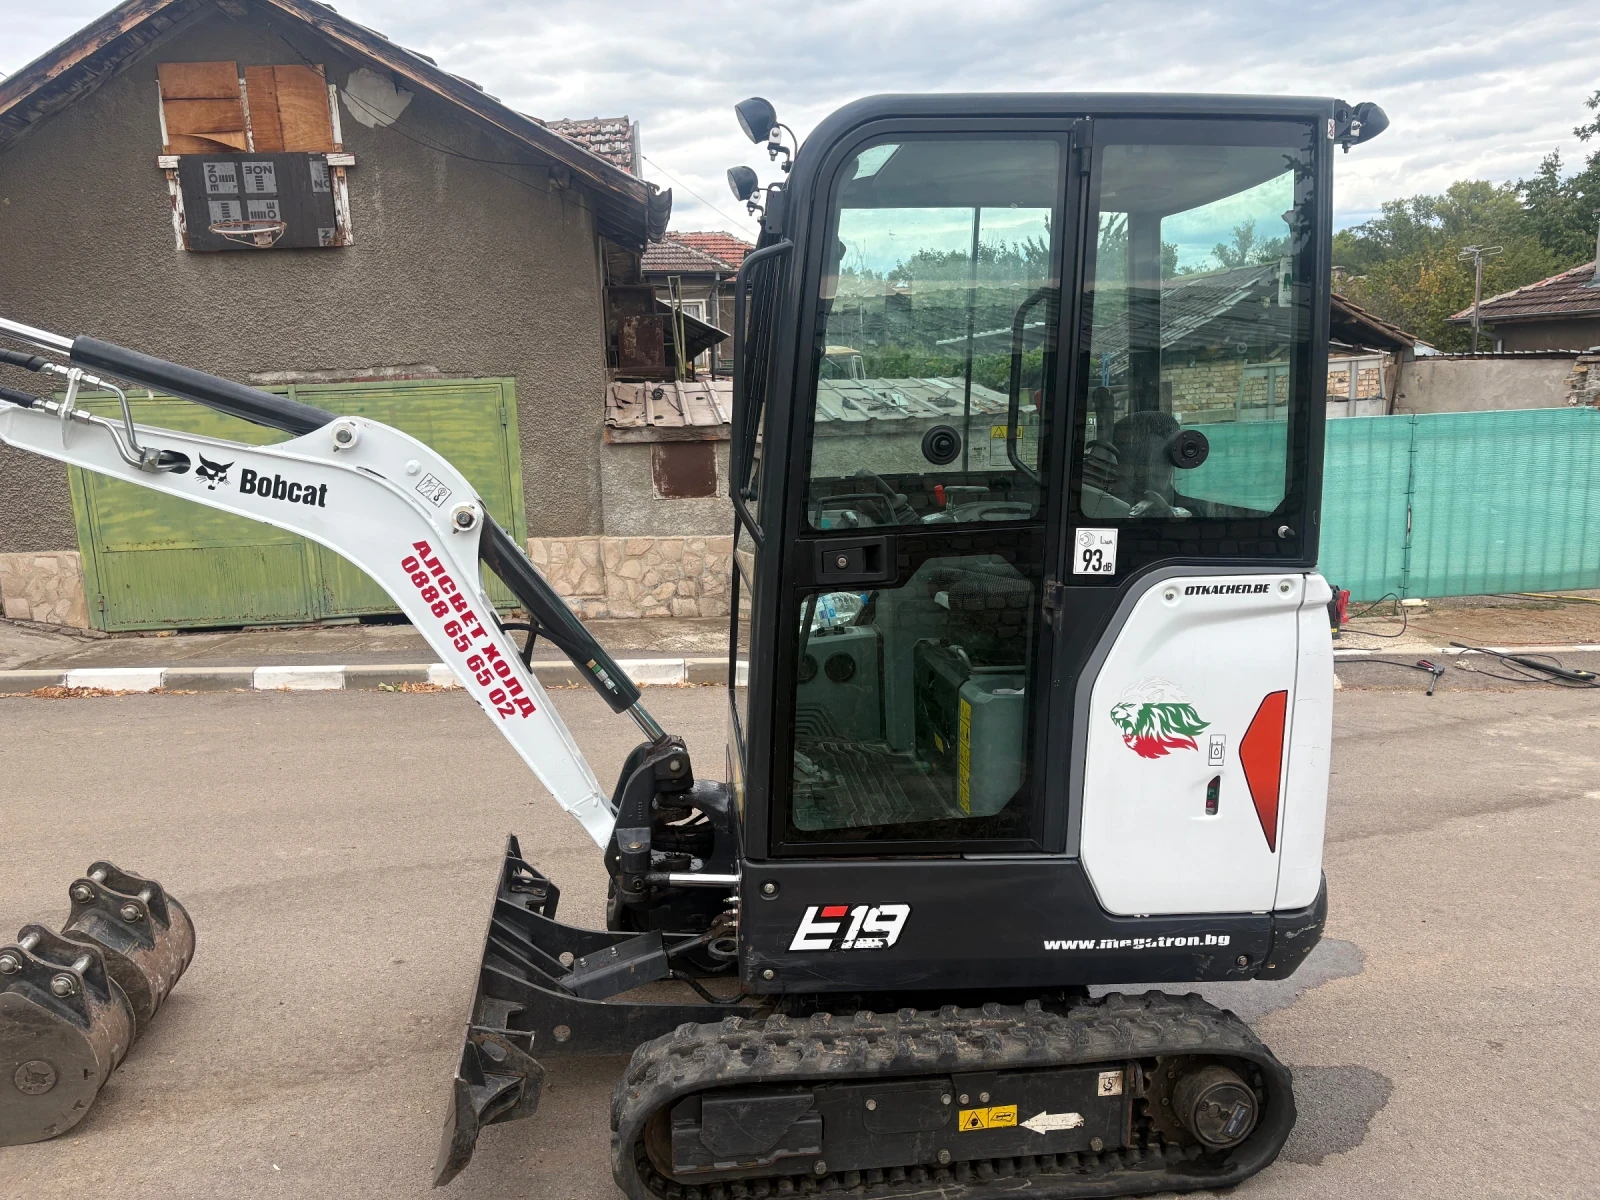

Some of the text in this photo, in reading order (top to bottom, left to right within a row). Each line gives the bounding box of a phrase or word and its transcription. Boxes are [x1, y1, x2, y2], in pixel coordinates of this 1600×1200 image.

[207, 164, 219, 192] NOE
[244, 165, 273, 175] NOE
[239, 468, 328, 508] Bobcat
[1082, 548, 1113, 572] 93 dB
[1184, 583, 1271, 596] OTKACHEN.BE
[400, 555, 517, 720] 0888 65 65 02
[412, 540, 537, 719] АЛСВЕТ ХОЛД
[788, 904, 911, 951] E19
[1043, 933, 1231, 951] www.megatron.bg
